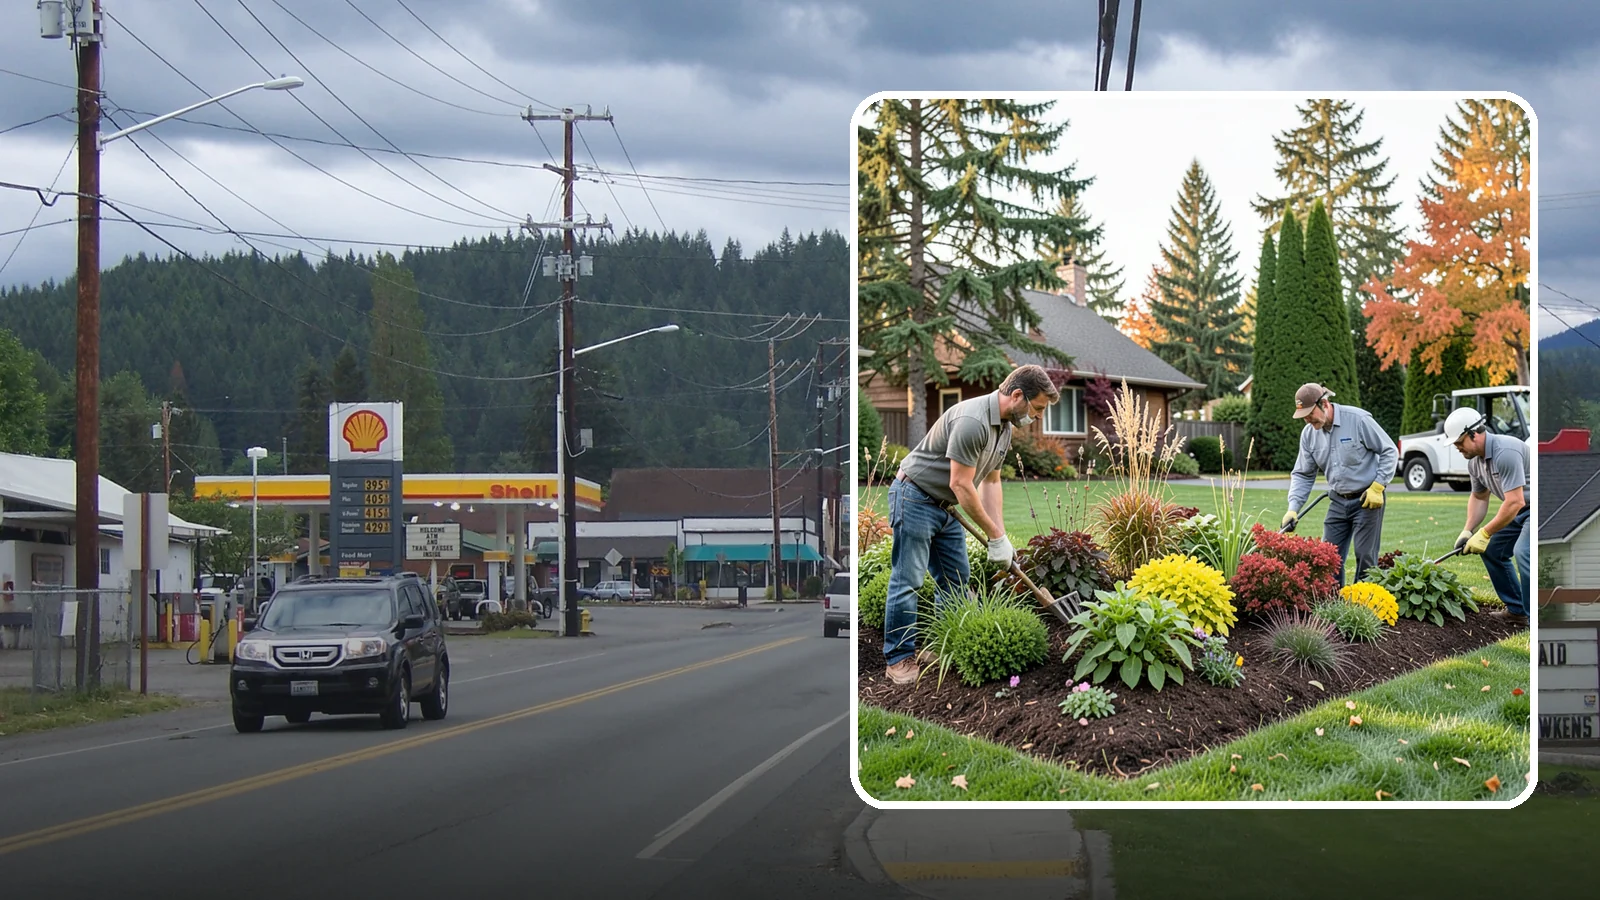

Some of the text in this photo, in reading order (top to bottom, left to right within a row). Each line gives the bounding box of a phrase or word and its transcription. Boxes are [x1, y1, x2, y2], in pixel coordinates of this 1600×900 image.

[366, 479, 383, 490] 395
[490, 484, 547, 499] Shell
[366, 494, 383, 504] 405
[366, 508, 383, 518] 415
[366, 522, 383, 533] 429
